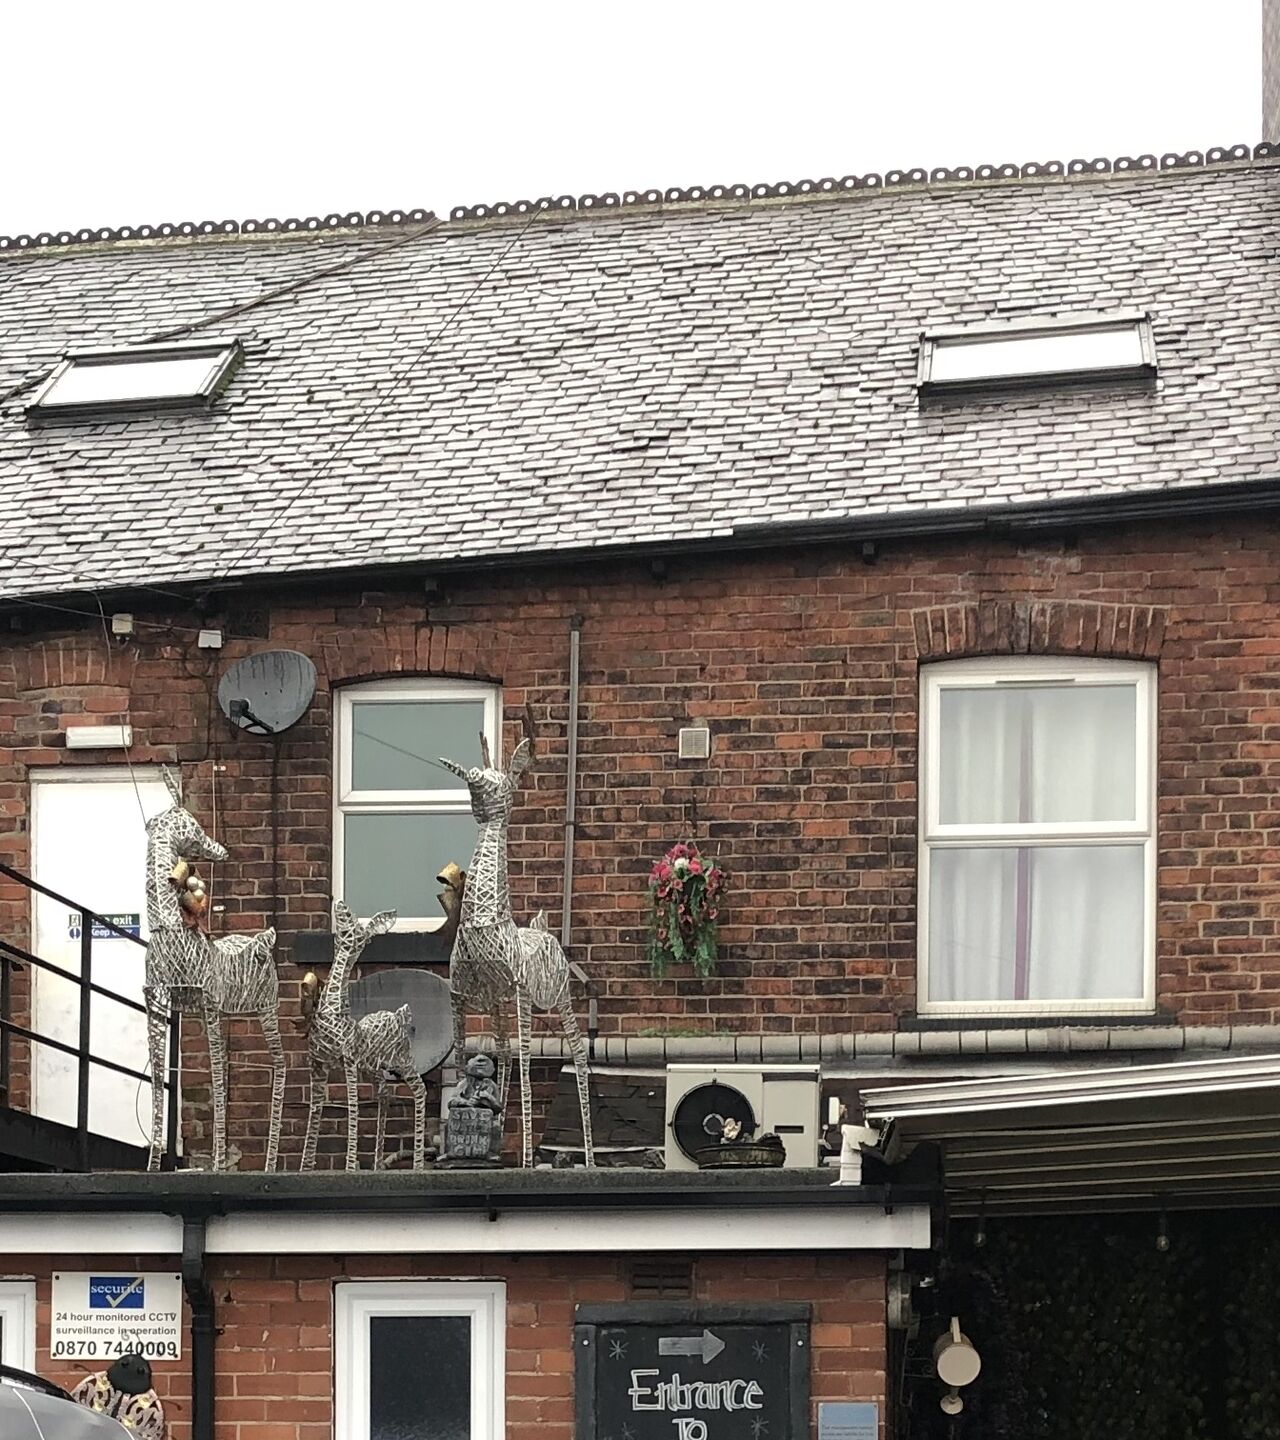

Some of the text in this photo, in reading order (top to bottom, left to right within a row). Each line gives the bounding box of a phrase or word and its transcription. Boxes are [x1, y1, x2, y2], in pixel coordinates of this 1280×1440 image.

[113, 915, 133, 925] exit
[450, 1135, 489, 1145] DRINK
[56, 1312, 177, 1321] 24 hour monitored CCTV
[56, 1326, 177, 1337] surveillance in operation
[56, 1341, 177, 1356] 0870 7440009
[628, 1369, 763, 1412] Entrance
